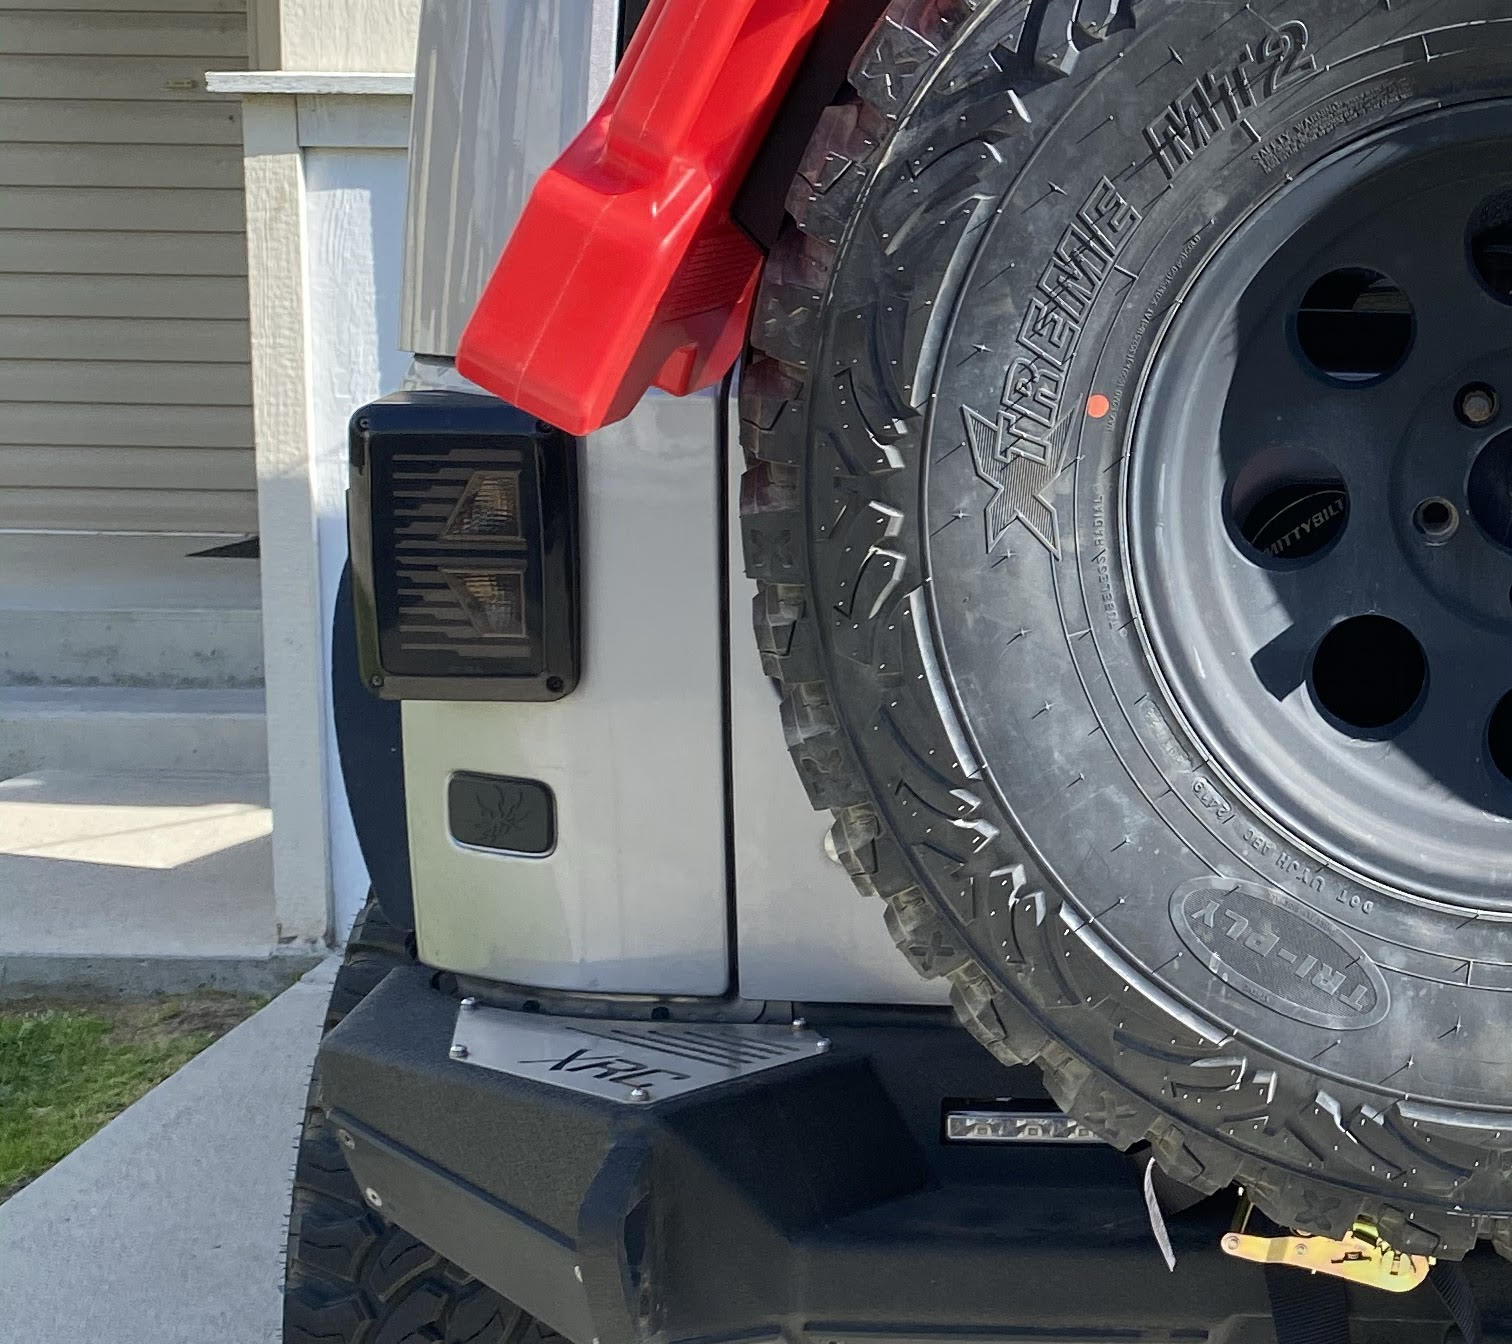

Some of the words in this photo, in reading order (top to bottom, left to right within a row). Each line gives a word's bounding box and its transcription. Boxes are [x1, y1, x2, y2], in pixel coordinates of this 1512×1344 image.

[1258, 497, 1346, 559] MITTYBILT
[1334, 887, 1374, 917] DOT
[1190, 889, 1372, 1011] TRI-PLY
[518, 1048, 690, 1089] XRC
